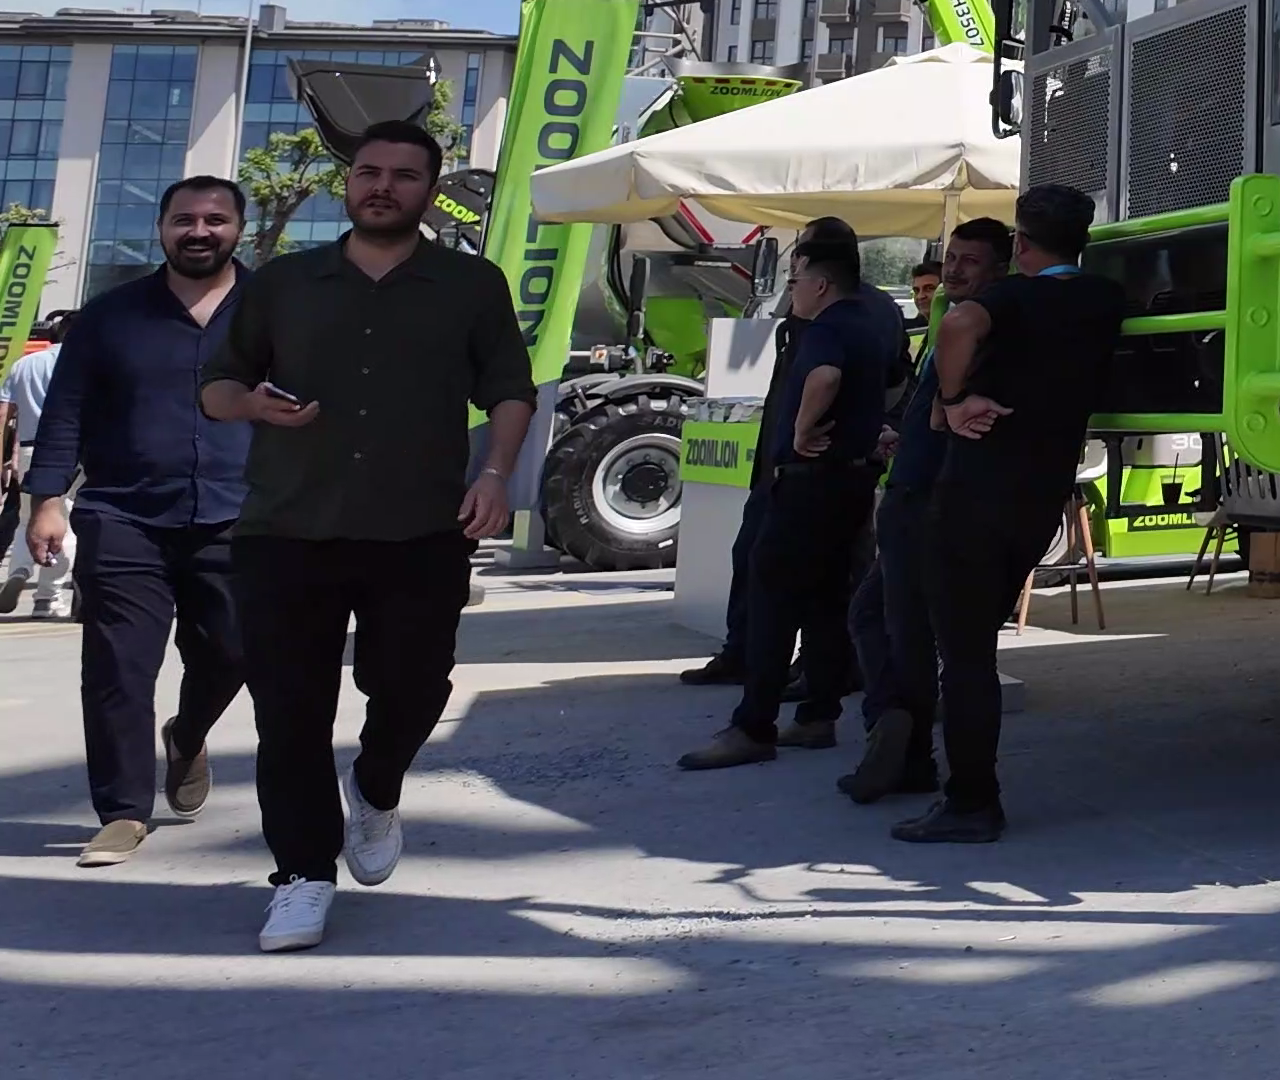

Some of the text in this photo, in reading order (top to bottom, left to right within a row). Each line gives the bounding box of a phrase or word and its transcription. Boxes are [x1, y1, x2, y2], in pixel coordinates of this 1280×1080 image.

[709, 86, 783, 97] ZOOMLION
[433, 192, 482, 231] ZOOM
[515, 38, 595, 348] ZOOLION
[0, 245, 37, 378] ZOOMLIO
[685, 438, 739, 469] ZOOMLION
